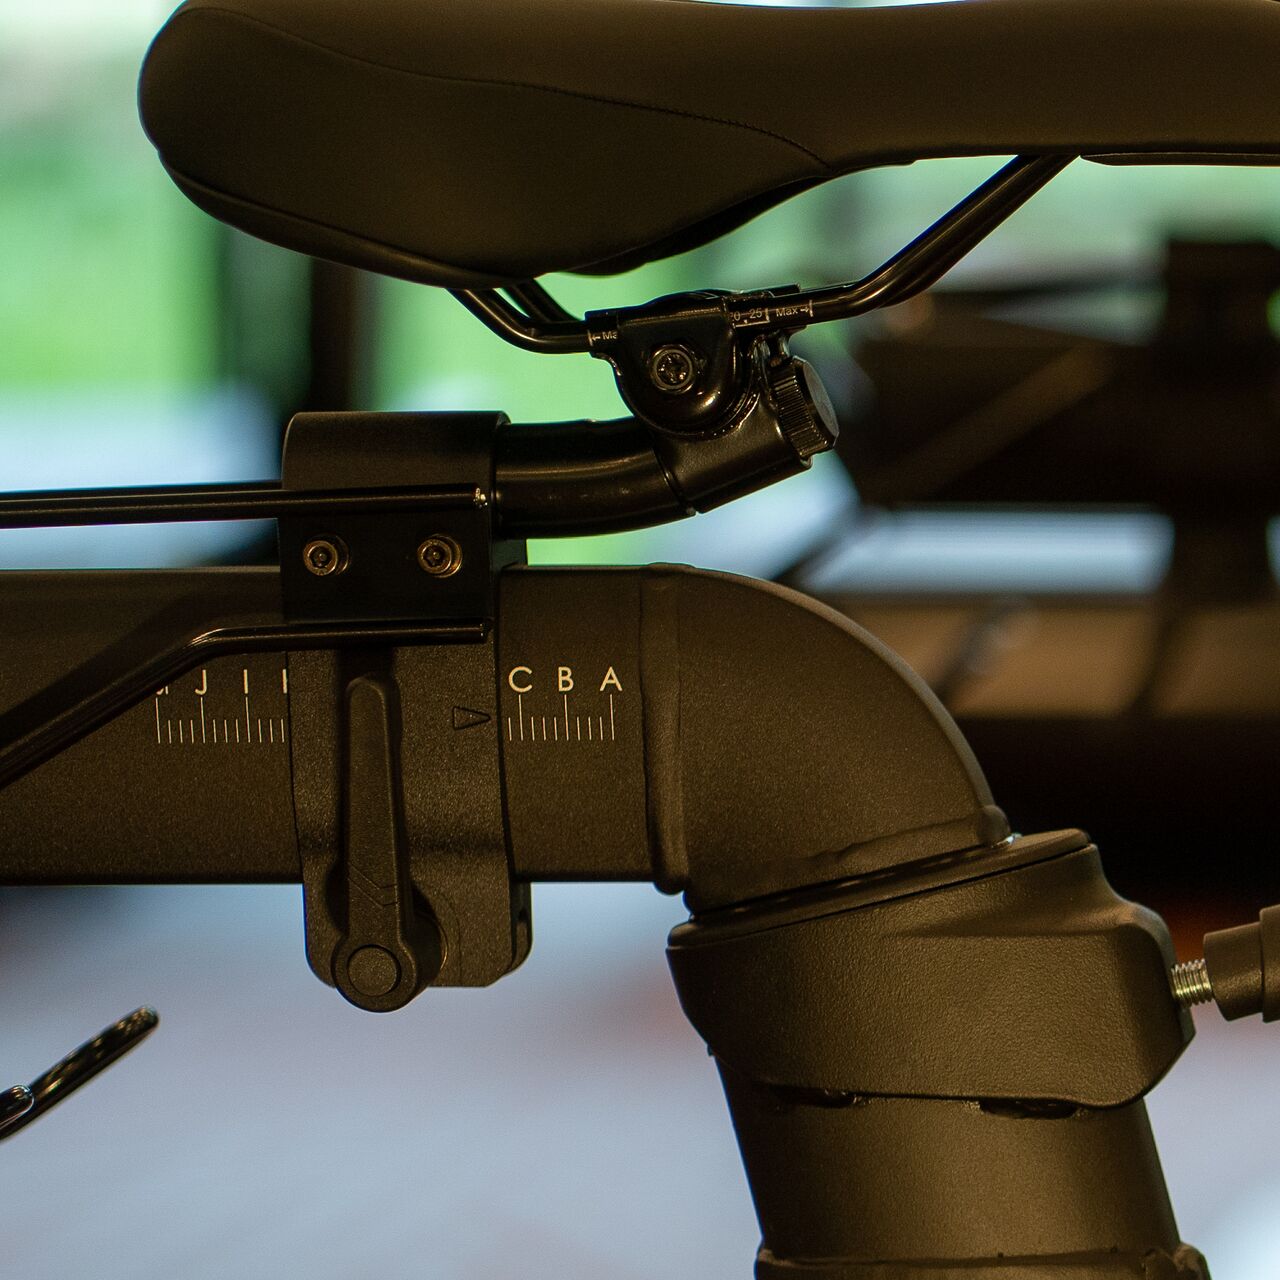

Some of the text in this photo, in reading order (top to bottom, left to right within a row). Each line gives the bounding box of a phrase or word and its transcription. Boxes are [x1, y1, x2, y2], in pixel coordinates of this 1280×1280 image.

[775, 307, 798, 317] Max
[195, 669, 207, 695] J
[508, 665, 533, 693] C
[558, 666, 574, 692] B
[599, 666, 623, 691] A
